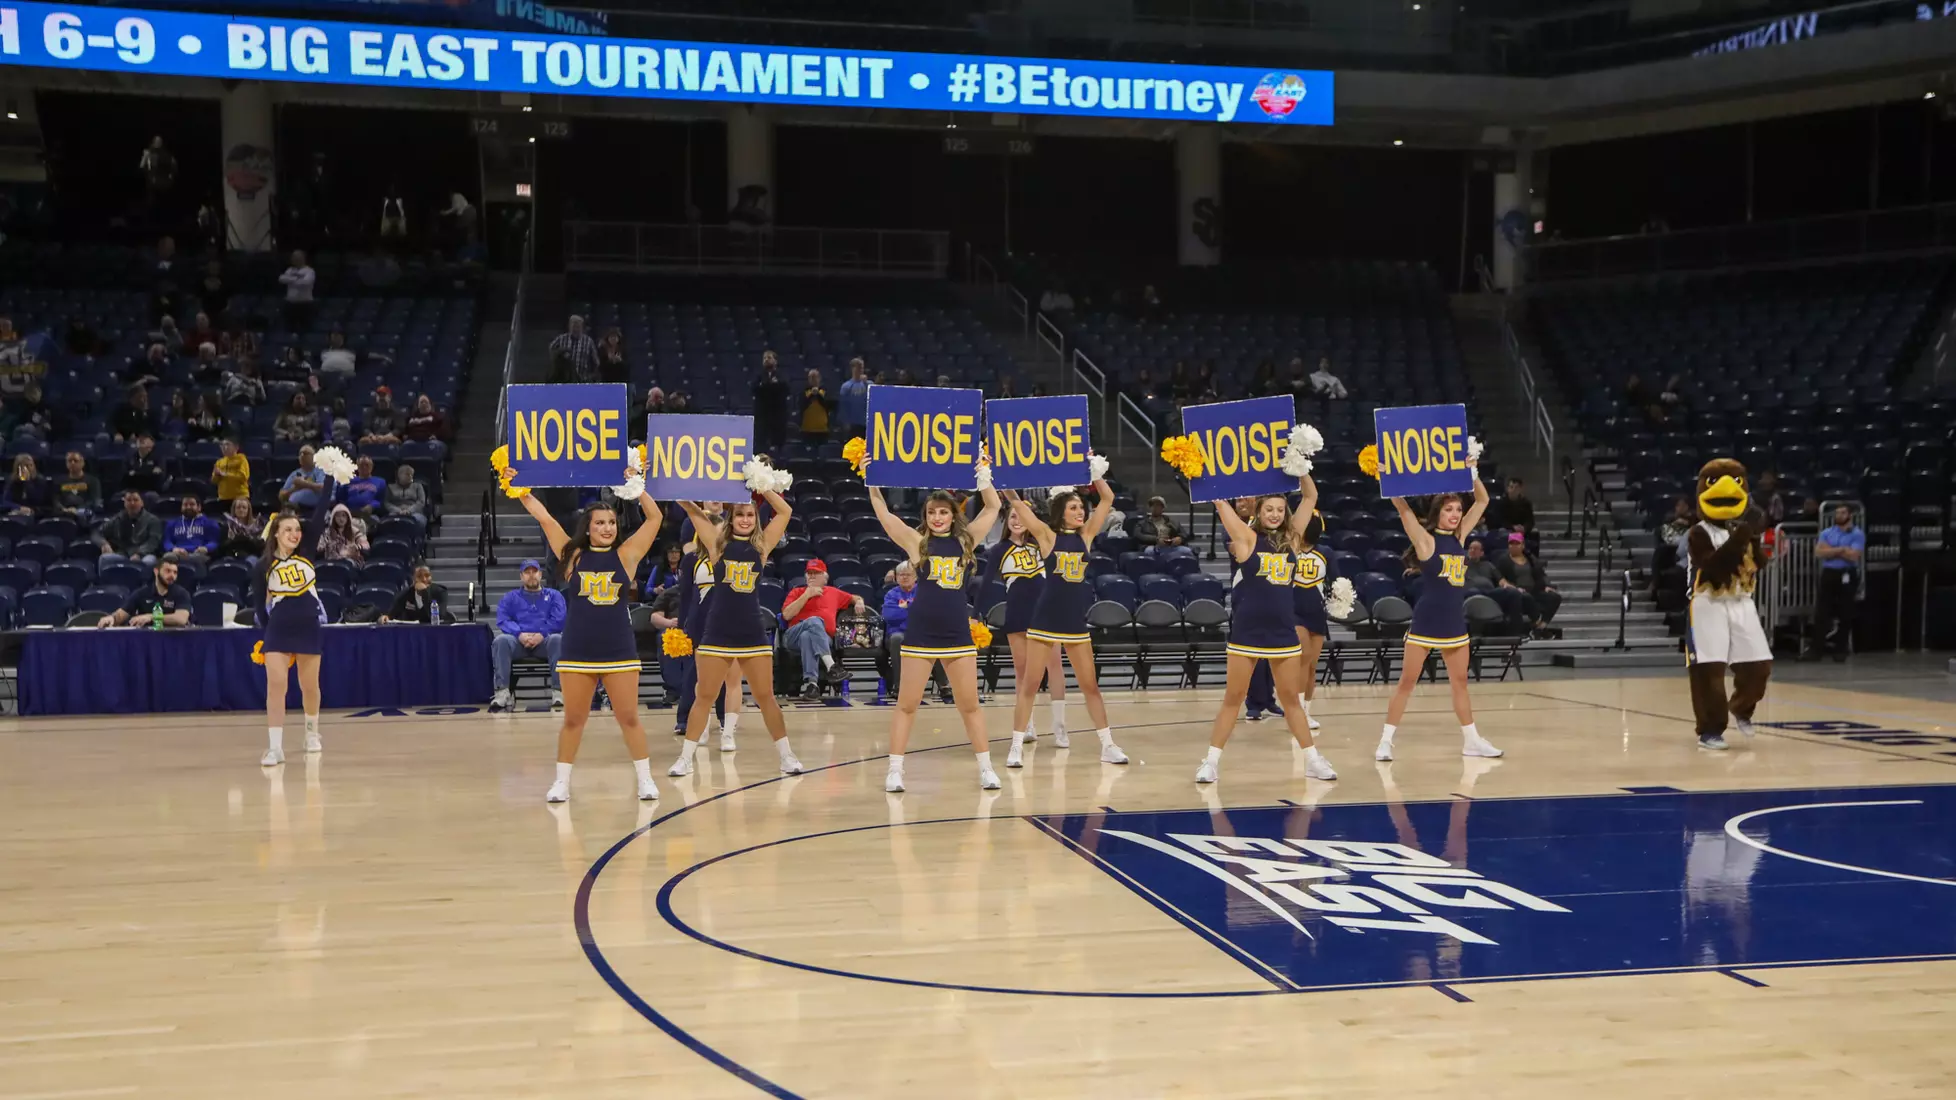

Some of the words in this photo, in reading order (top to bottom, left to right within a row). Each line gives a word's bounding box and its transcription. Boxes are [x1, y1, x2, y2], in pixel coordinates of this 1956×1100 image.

[227, 23, 330, 74] BIG
[349, 30, 498, 82] EAST
[512, 39, 893, 99] TOURNAMENT
[948, 63, 1244, 122] #BEtourney
[515, 408, 620, 462] NOISE
[873, 411, 974, 464] NOISE
[993, 418, 1084, 466] NOISE
[1382, 426, 1466, 475] NOISE
[652, 435, 746, 480] NOISE
[276, 563, 307, 588] MU
[722, 560, 760, 593] MU
[927, 556, 964, 590] MU
[1013, 549, 1038, 570] MU
[1053, 551, 1088, 583] MU
[1256, 552, 1295, 586] MU
[577, 571, 623, 605] MU
